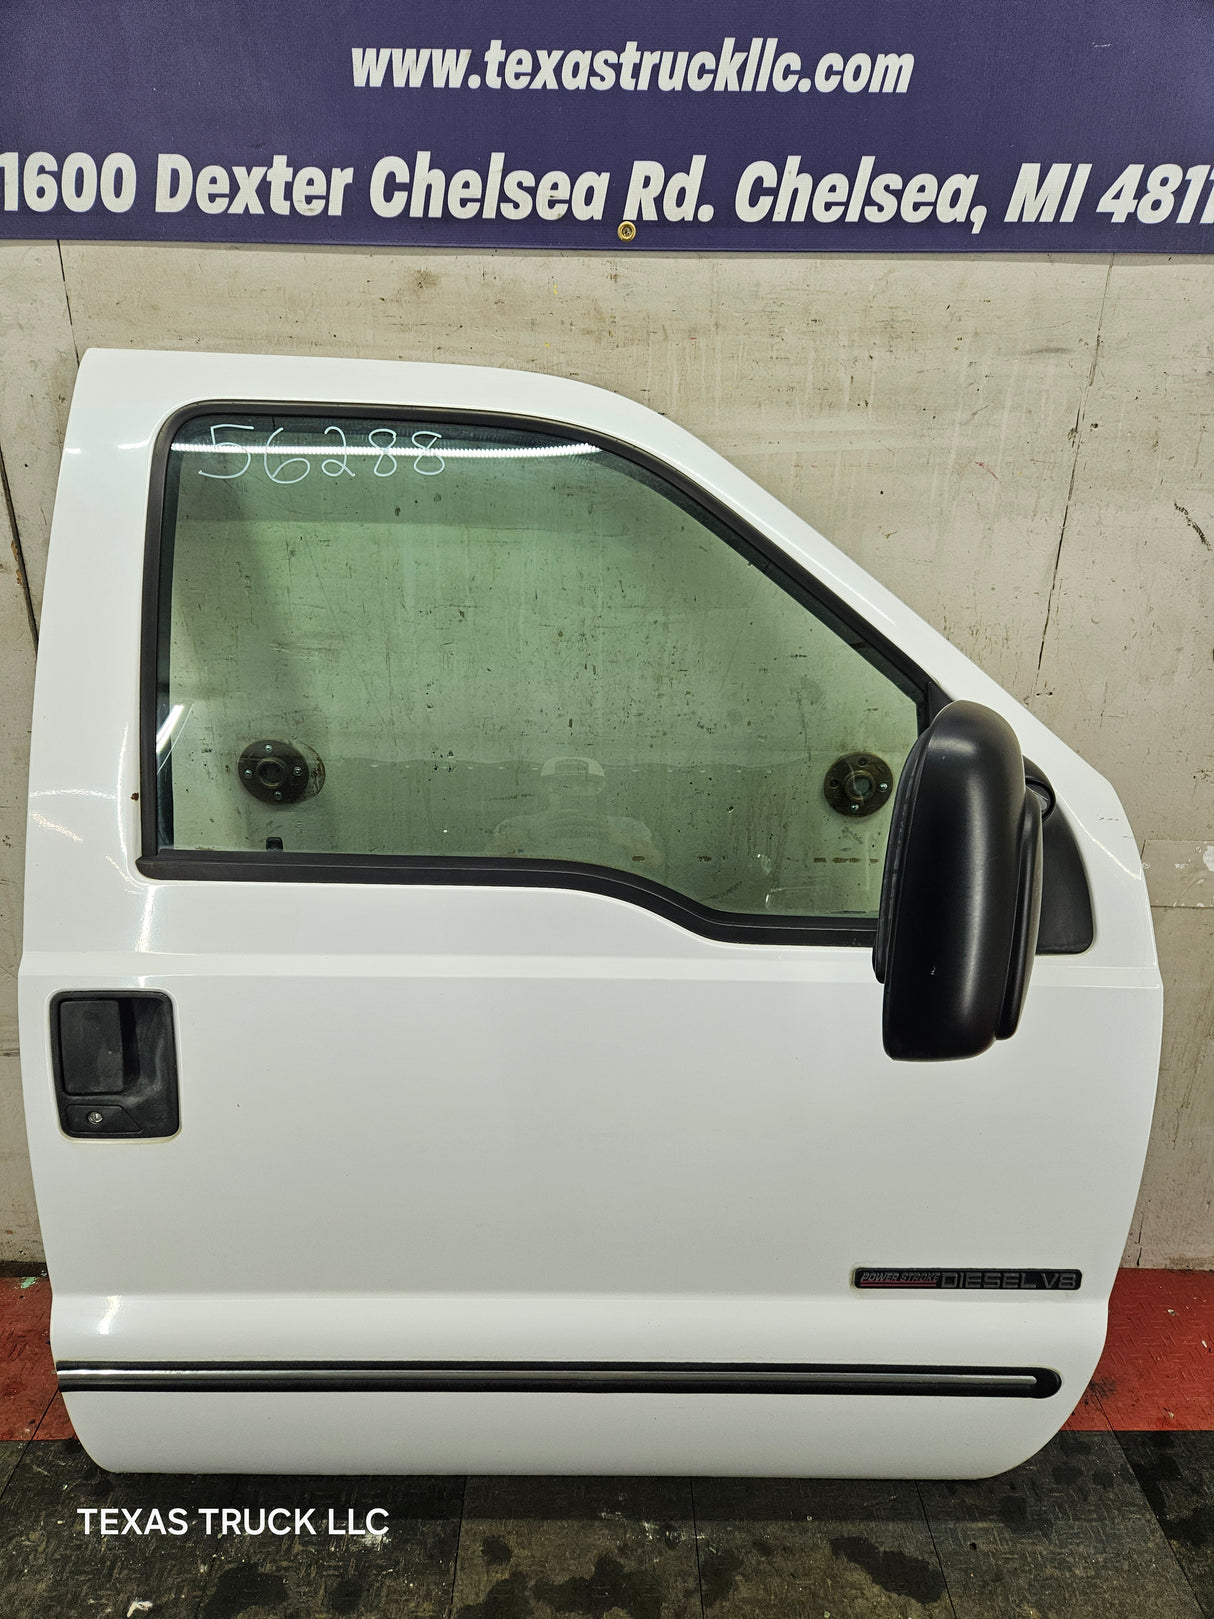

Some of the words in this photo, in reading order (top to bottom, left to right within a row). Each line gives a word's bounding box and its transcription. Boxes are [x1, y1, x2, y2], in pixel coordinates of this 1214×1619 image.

[351, 37, 915, 93] www.texastruckllc.com
[0, 151, 137, 213] 1600
[155, 153, 354, 217] Dexter
[369, 150, 611, 221] Chelsea
[622, 154, 715, 223] Rd.
[735, 155, 988, 235] Chelsea,
[1003, 162, 1093, 223] MI
[198, 423, 446, 484] 56288
[861, 1272, 899, 1282] POWER
[900, 1272, 941, 1282] STROKE
[941, 1271, 1037, 1289] DIESEL
[1042, 1272, 1078, 1289] V8
